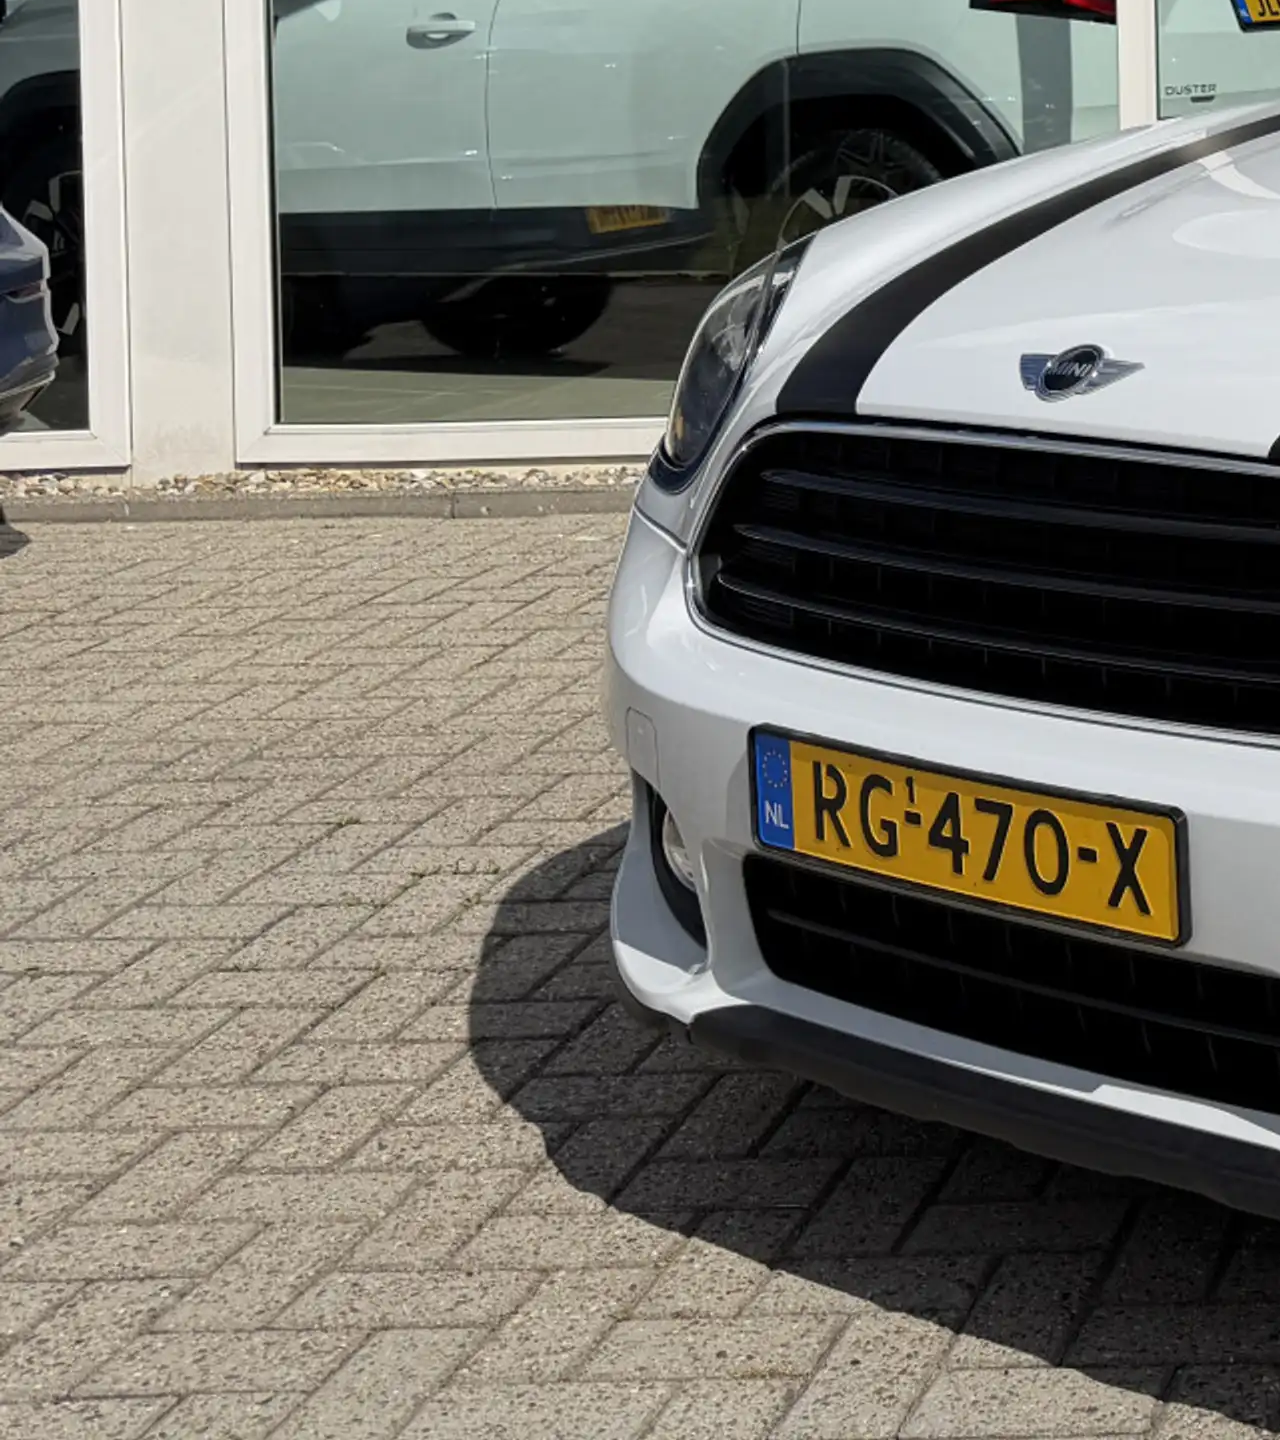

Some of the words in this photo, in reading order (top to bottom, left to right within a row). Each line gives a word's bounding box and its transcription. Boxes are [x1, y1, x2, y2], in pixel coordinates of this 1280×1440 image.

[1164, 83, 1217, 96] DUSTER
[1047, 361, 1093, 378] MINI
[764, 800, 790, 830] NL
[812, 760, 1152, 916] RG-470-X
